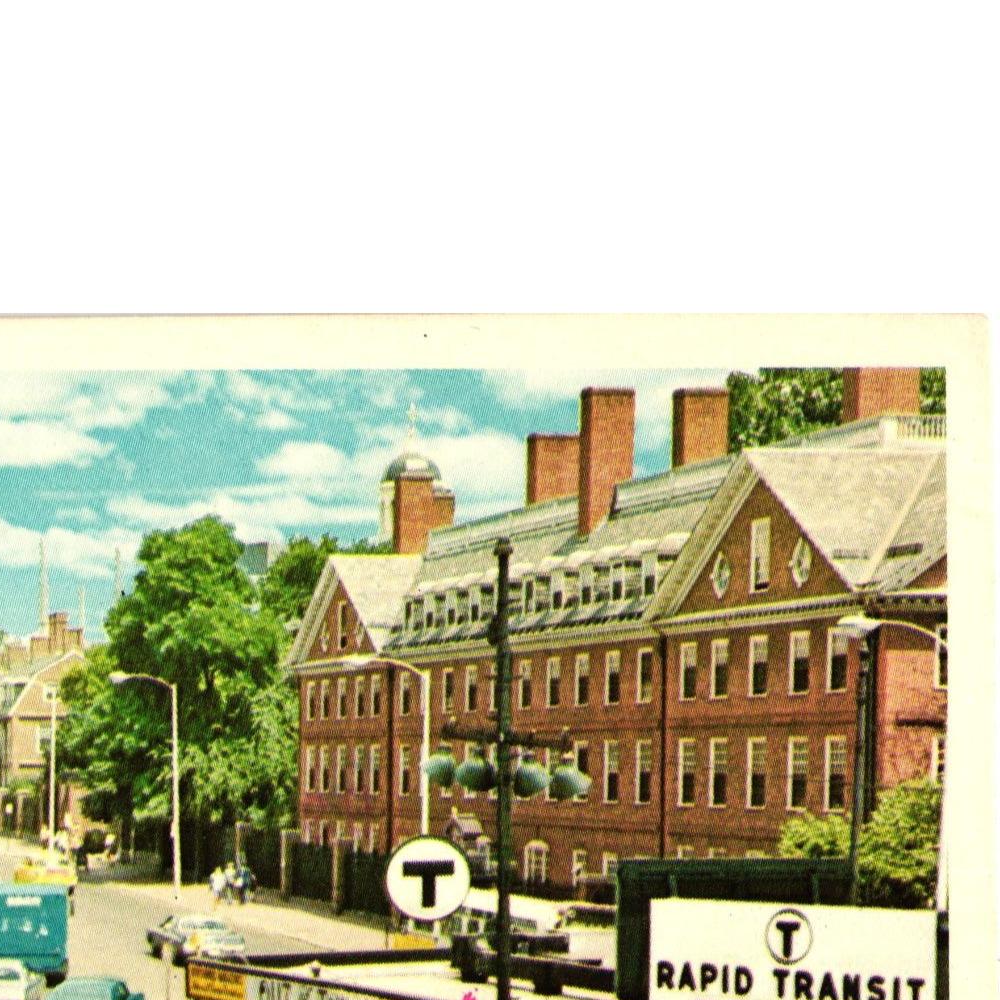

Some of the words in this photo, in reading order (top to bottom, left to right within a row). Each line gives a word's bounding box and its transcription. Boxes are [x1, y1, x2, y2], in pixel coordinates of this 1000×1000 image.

[403, 860, 455, 908] T
[776, 921, 800, 958] T
[657, 961, 753, 996] RAPID
